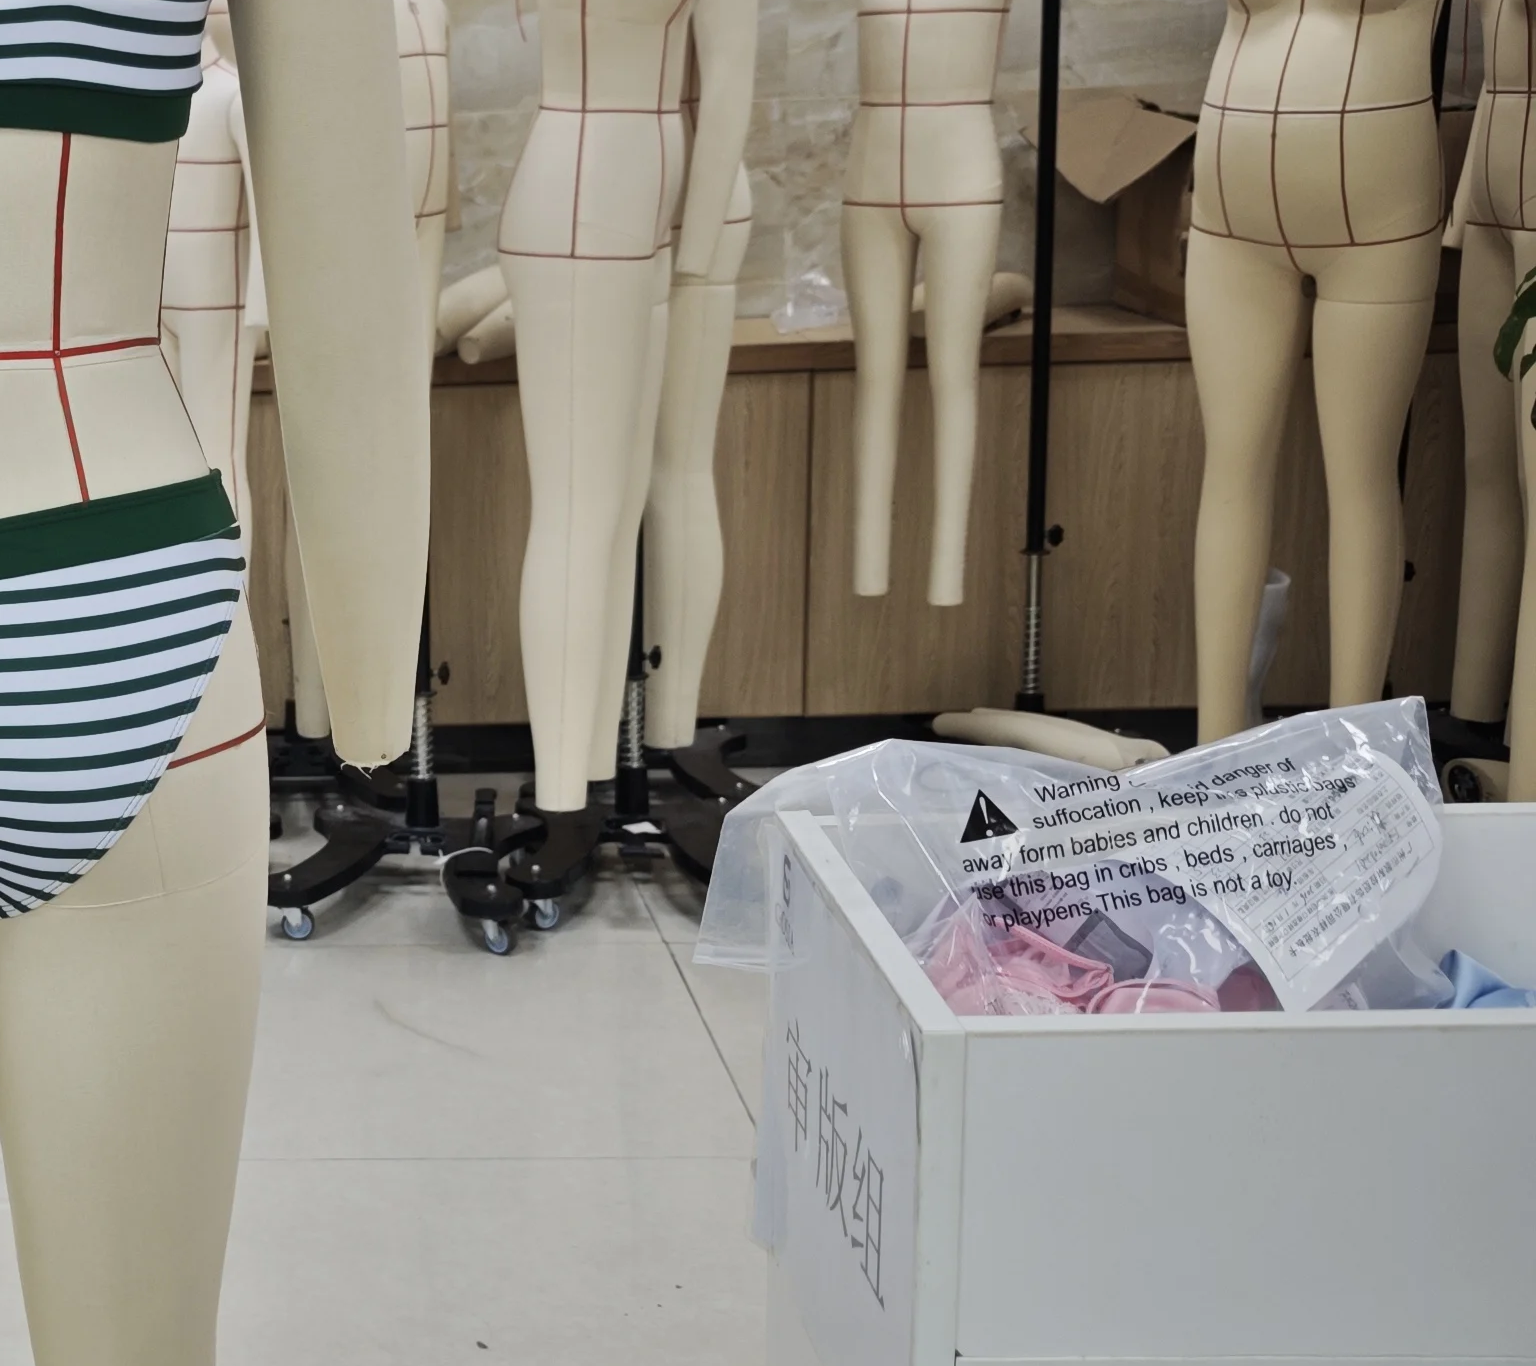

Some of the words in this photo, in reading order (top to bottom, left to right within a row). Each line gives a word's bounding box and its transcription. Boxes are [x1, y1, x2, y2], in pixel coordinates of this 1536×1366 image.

[1034, 774, 1121, 803] Warning
[1211, 762, 1273, 787] danger
[1276, 757, 1297, 773] of
[962, 852, 1013, 873] away
[1019, 844, 1064, 865] form
[1070, 830, 1137, 856] babies
[1143, 820, 1181, 844] and
[1187, 812, 1264, 837] children
[1279, 805, 1302, 825] do
[1307, 801, 1335, 822] not
[1032, 798, 1142, 830] suffocation
[1157, 788, 1209, 809] keep
[971, 884, 1005, 901] use
[1011, 874, 1047, 897] this
[1050, 869, 1090, 890] bag
[1094, 864, 1114, 883] in
[1118, 855, 1168, 879] cribs
[1183, 845, 1235, 868] beds
[1252, 833, 1337, 859] carriages
[1146, 883, 1187, 905] bag
[1189, 878, 1208, 898] is
[1213, 873, 1245, 895] not
[1250, 875, 1263, 889] a
[1266, 868, 1298, 892] toy.
[786, 1019, 885, 1311] 审版组
